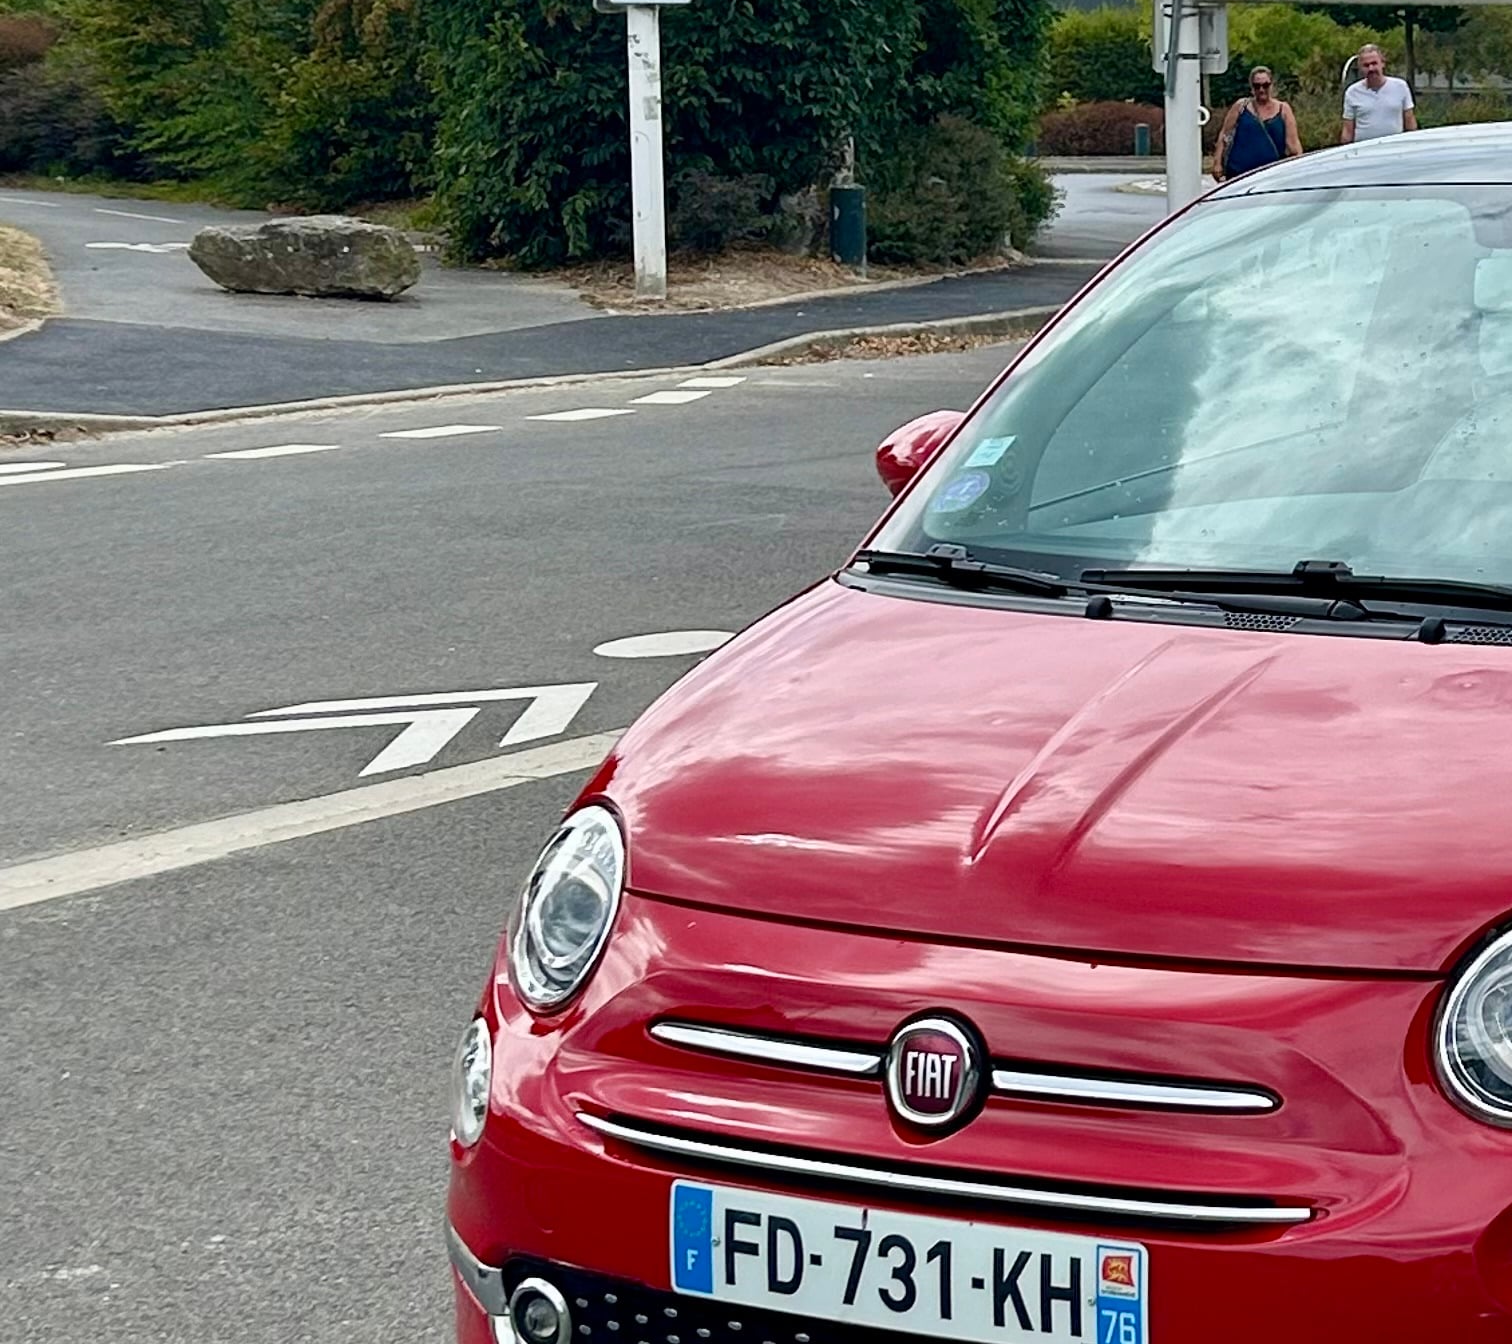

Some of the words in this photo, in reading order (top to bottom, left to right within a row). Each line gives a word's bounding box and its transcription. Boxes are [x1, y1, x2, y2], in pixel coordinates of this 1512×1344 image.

[905, 1051, 958, 1100] FIAT
[686, 1248, 698, 1271] F
[724, 1207, 1083, 1338] FD-731-KH
